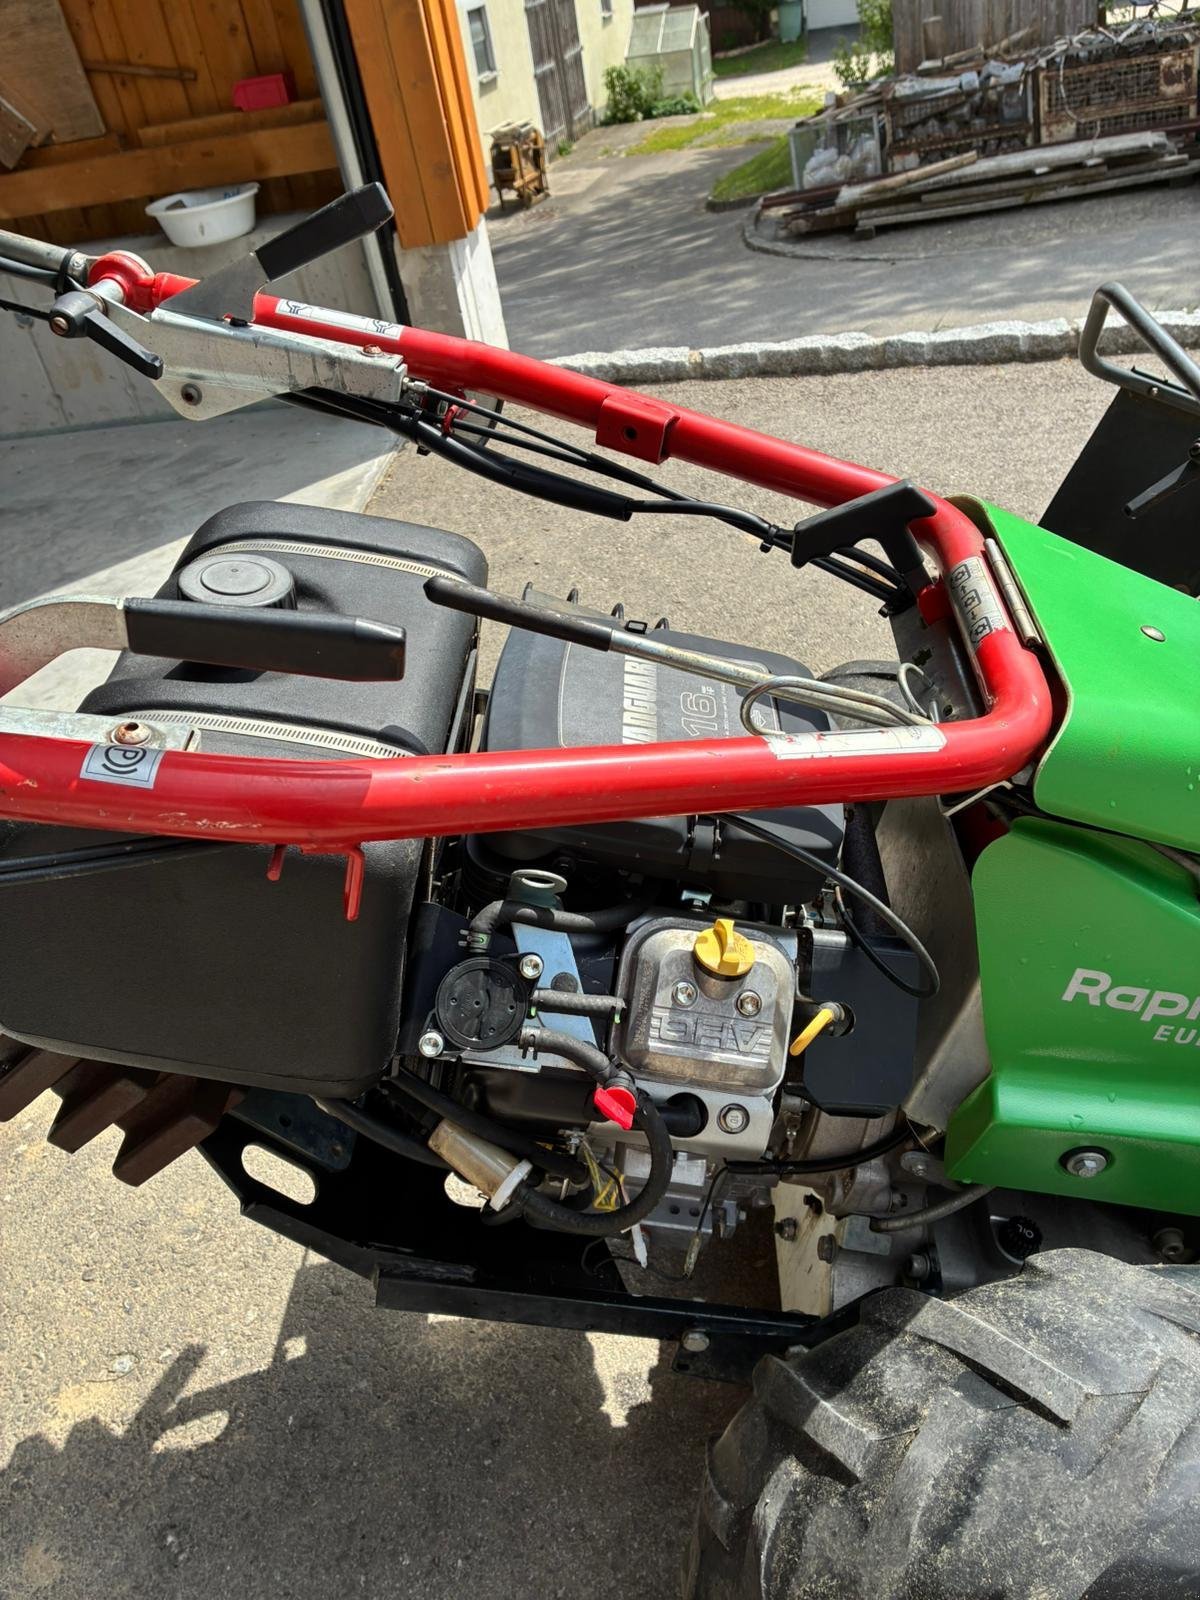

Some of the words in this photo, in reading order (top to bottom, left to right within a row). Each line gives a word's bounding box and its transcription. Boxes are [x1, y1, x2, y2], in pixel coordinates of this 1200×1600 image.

[680, 691, 718, 736] 16
[1153, 1025, 1200, 1047] EU
[1017, 1223, 1034, 1238] OIL
